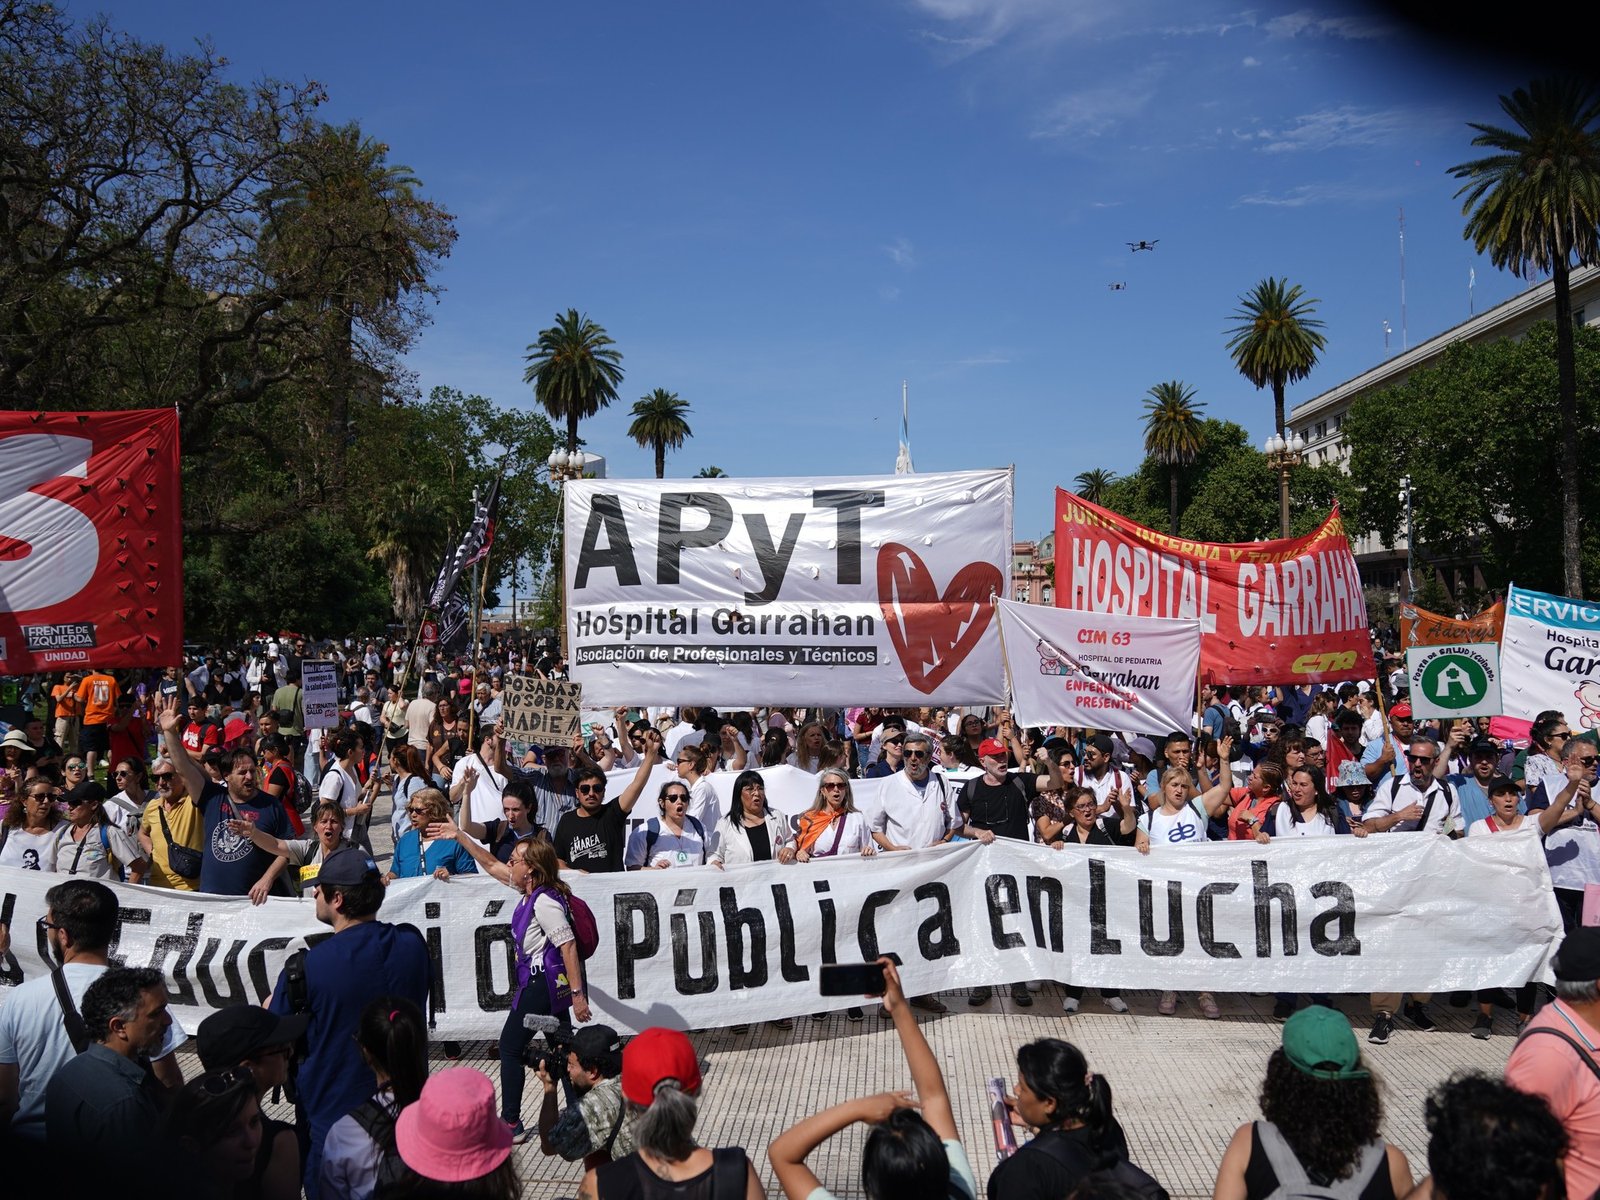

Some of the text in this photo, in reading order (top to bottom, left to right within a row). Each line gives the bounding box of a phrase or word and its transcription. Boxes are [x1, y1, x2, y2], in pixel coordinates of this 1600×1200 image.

[573, 489, 885, 606] APyT
[1071, 537, 1217, 634] HOSPITAL
[1509, 593, 1599, 623] ERVIC
[28, 625, 89, 637] FRENTE DE
[576, 607, 875, 641] Hospital Garrahan
[28, 634, 93, 647] IZQUIERDA
[1077, 628, 1131, 646] CIM 63
[44, 650, 86, 662] UNIDAD
[576, 645, 876, 665] Asociación de Profesionales y Técnicos
[1078, 654, 1162, 665] HOSPITAL DE PEDIATRIA
[1291, 650, 1358, 674] CTA
[1427, 652, 1438, 660] DE
[1438, 647, 1470, 656] SALUD
[503, 691, 521, 708] NO
[1075, 695, 1134, 711] PRESENTE
[504, 732, 568, 746] PACIENTES
[613, 879, 961, 1000] Pública
[984, 873, 1064, 953] en
[1088, 857, 1362, 959] Lucha
